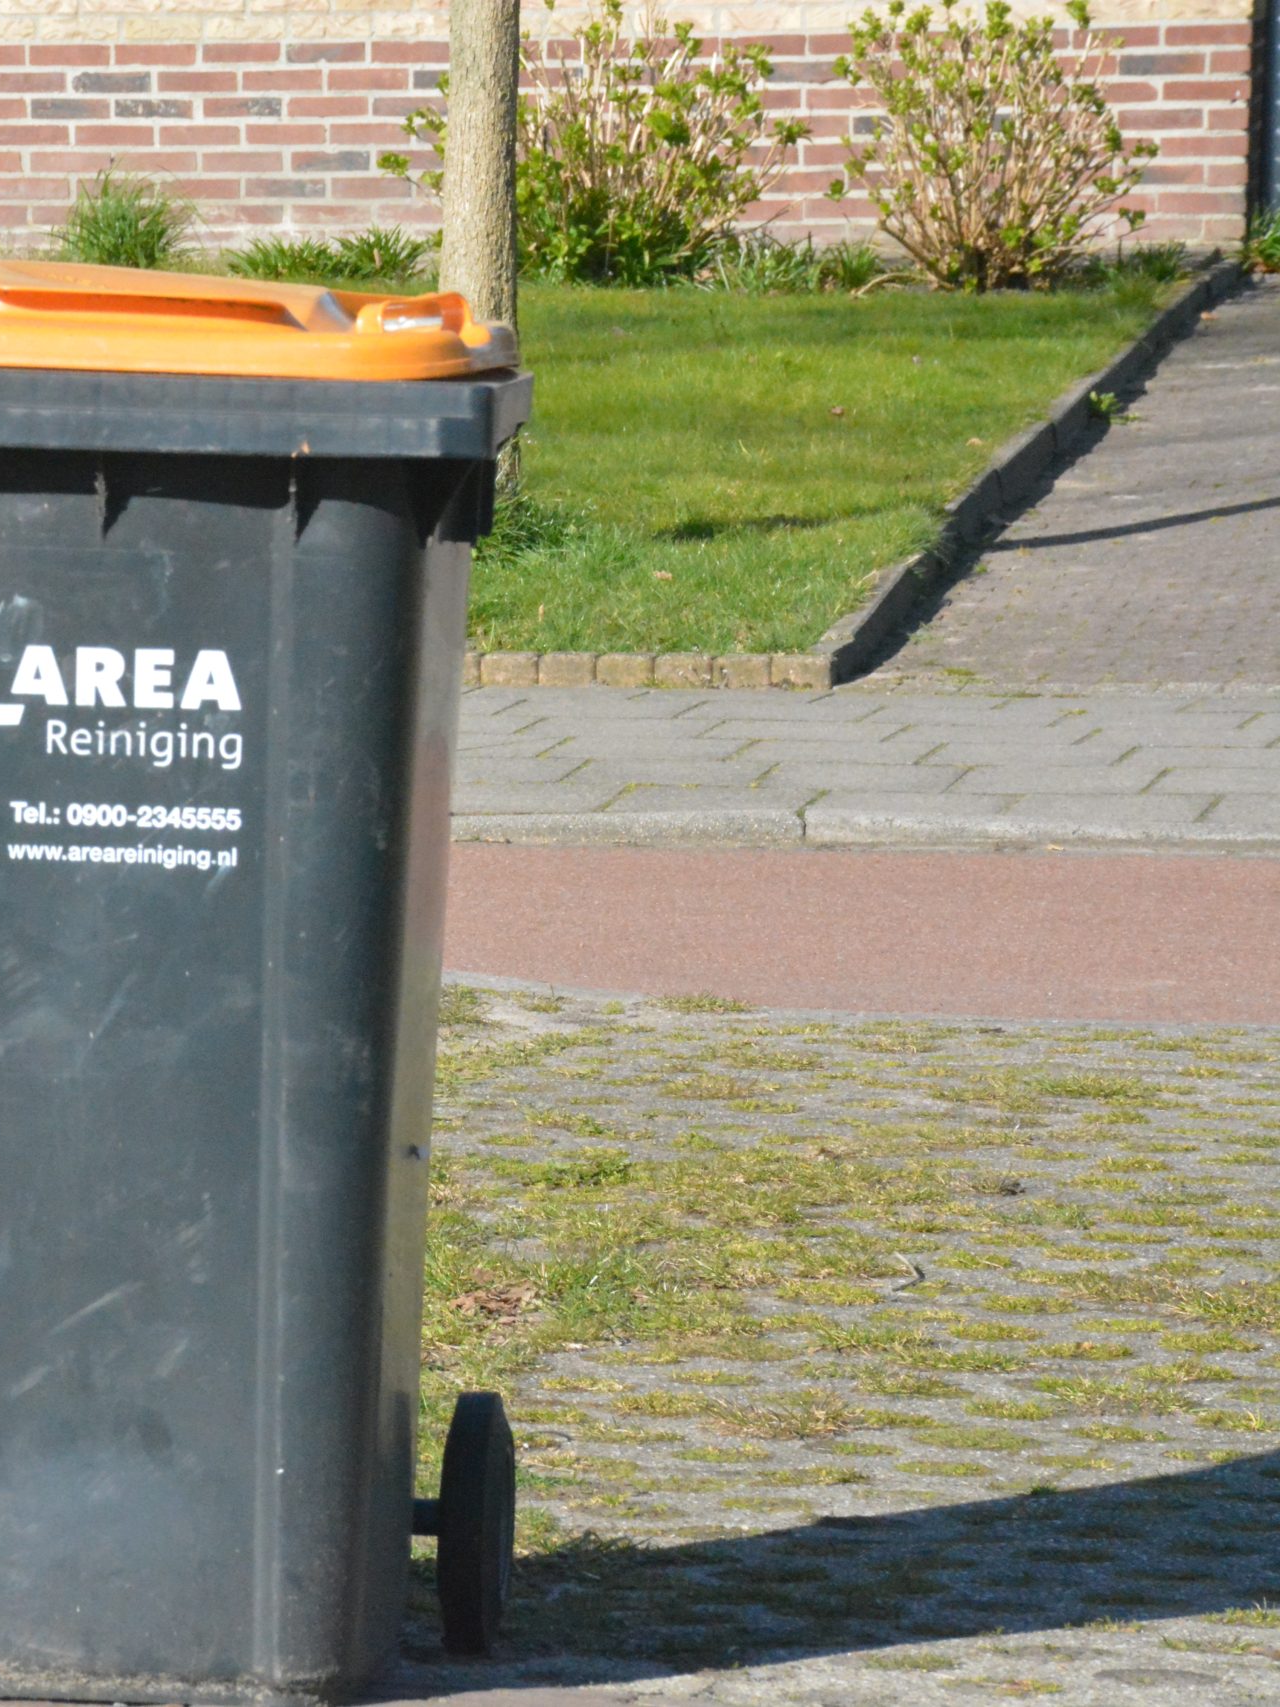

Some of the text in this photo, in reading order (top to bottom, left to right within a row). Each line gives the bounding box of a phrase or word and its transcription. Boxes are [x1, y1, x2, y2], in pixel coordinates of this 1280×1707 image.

[10, 645, 242, 711] AREA
[46, 719, 243, 770] Reiniging
[9, 801, 242, 831] Tel.: 0900-2345555
[7, 843, 238, 872] www.areareiniging.nl
